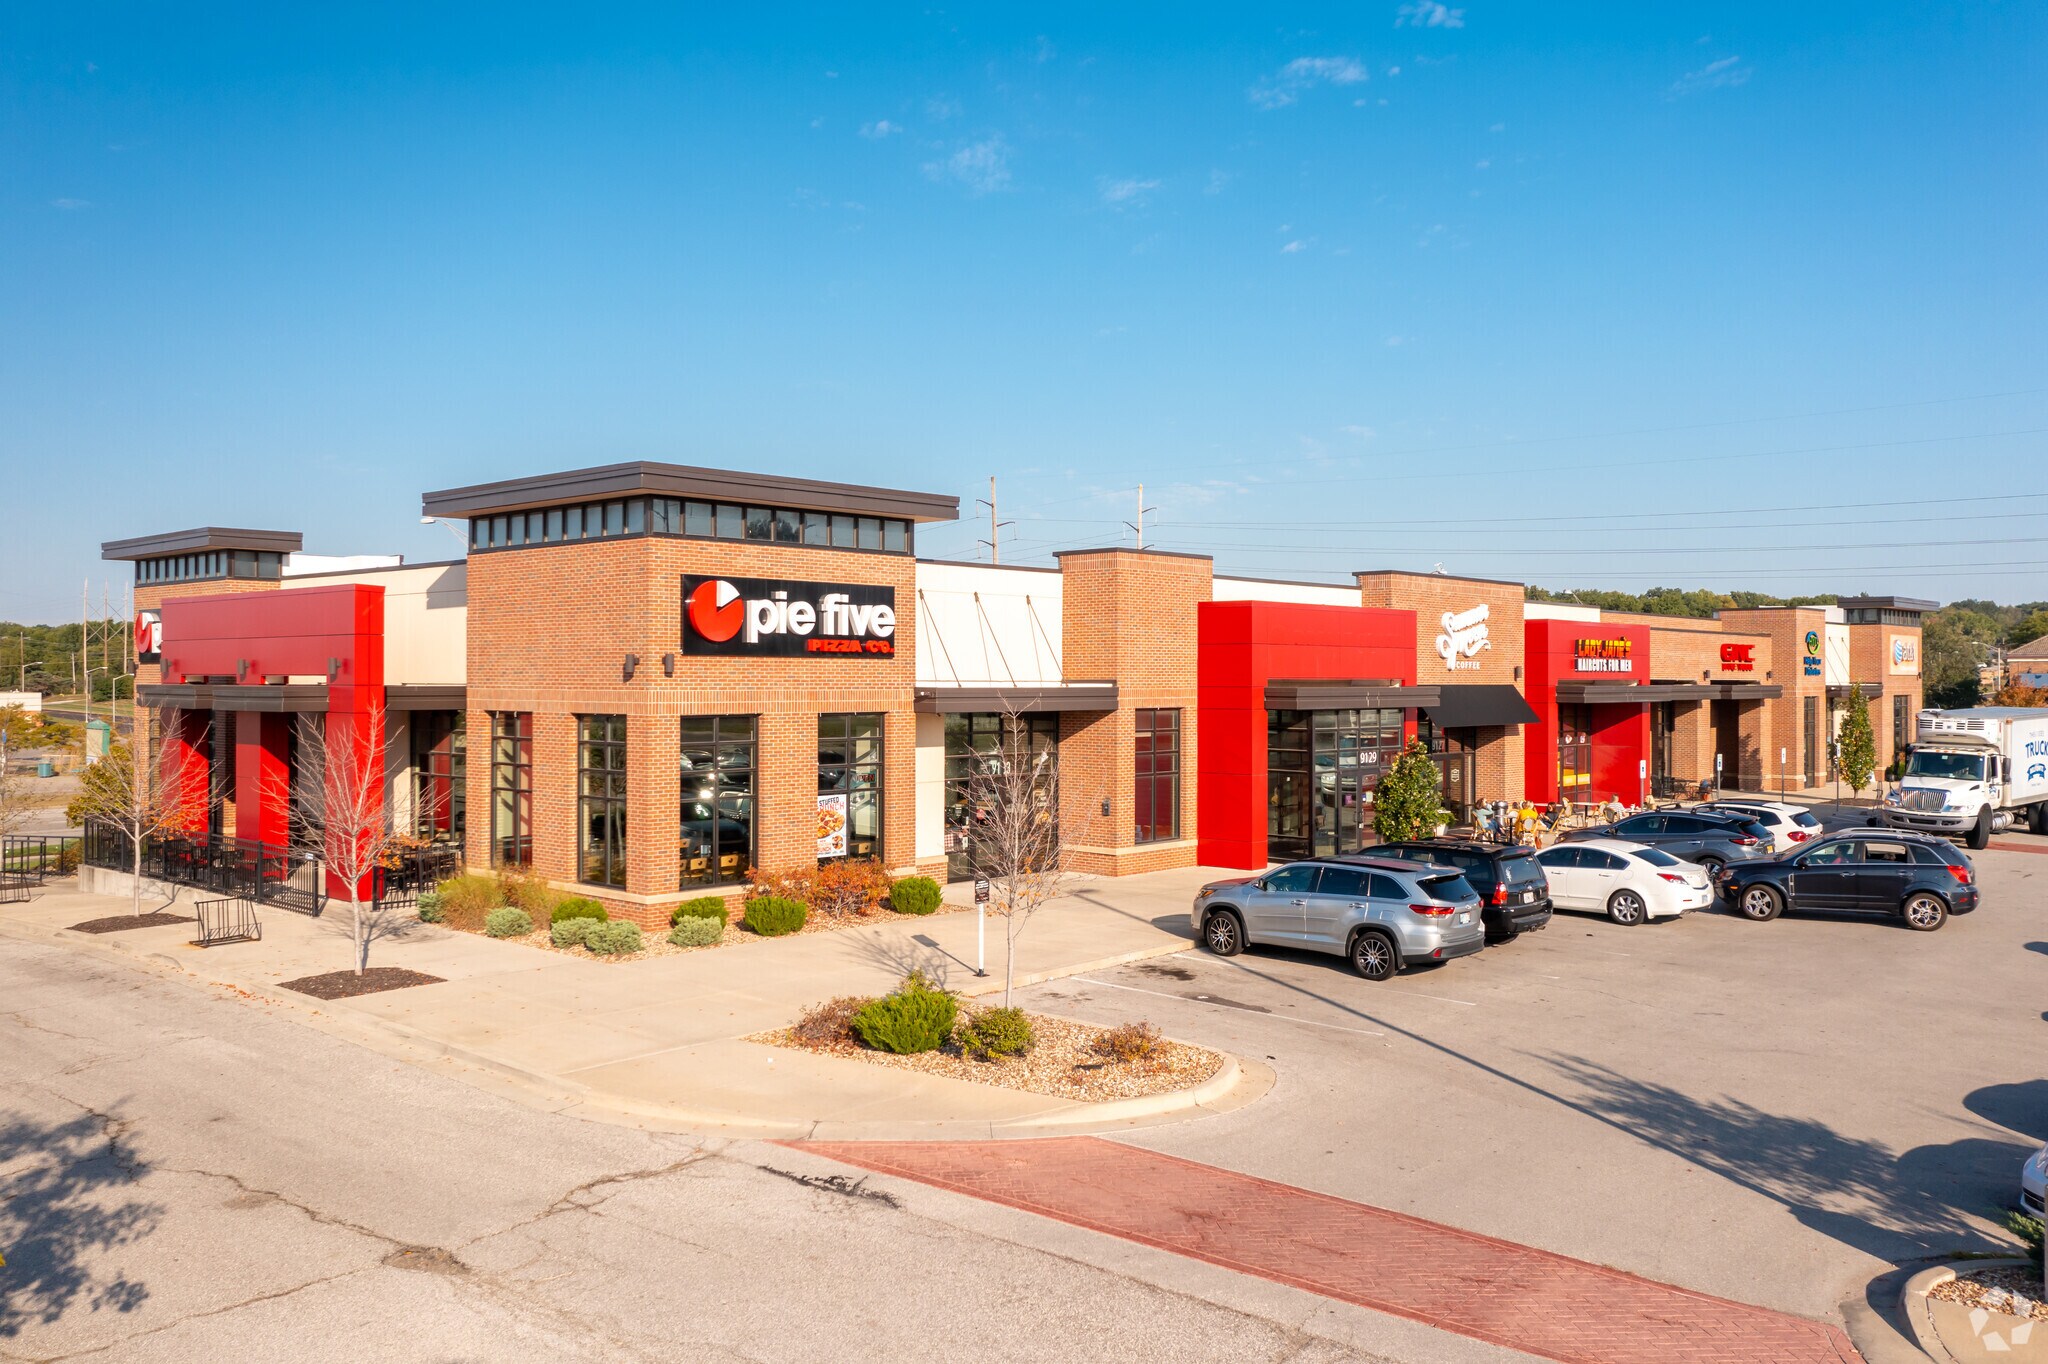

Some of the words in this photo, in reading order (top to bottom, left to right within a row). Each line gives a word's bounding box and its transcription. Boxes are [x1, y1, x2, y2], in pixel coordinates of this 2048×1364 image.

[742, 591, 816, 643] pie
[820, 593, 896, 638] five
[806, 639, 863, 653] PIZZA
[865, 641, 895, 654] CO.
[1575, 638, 1602, 657] LADY
[1456, 660, 1481, 669] COFFEE
[1575, 658, 1607, 671] HAIRCUTS
[1607, 659, 1620, 671] FOR
[1620, 659, 1632, 672] MEN
[1360, 752, 1377, 763] 9129
[819, 797, 839, 807] STUFFED
